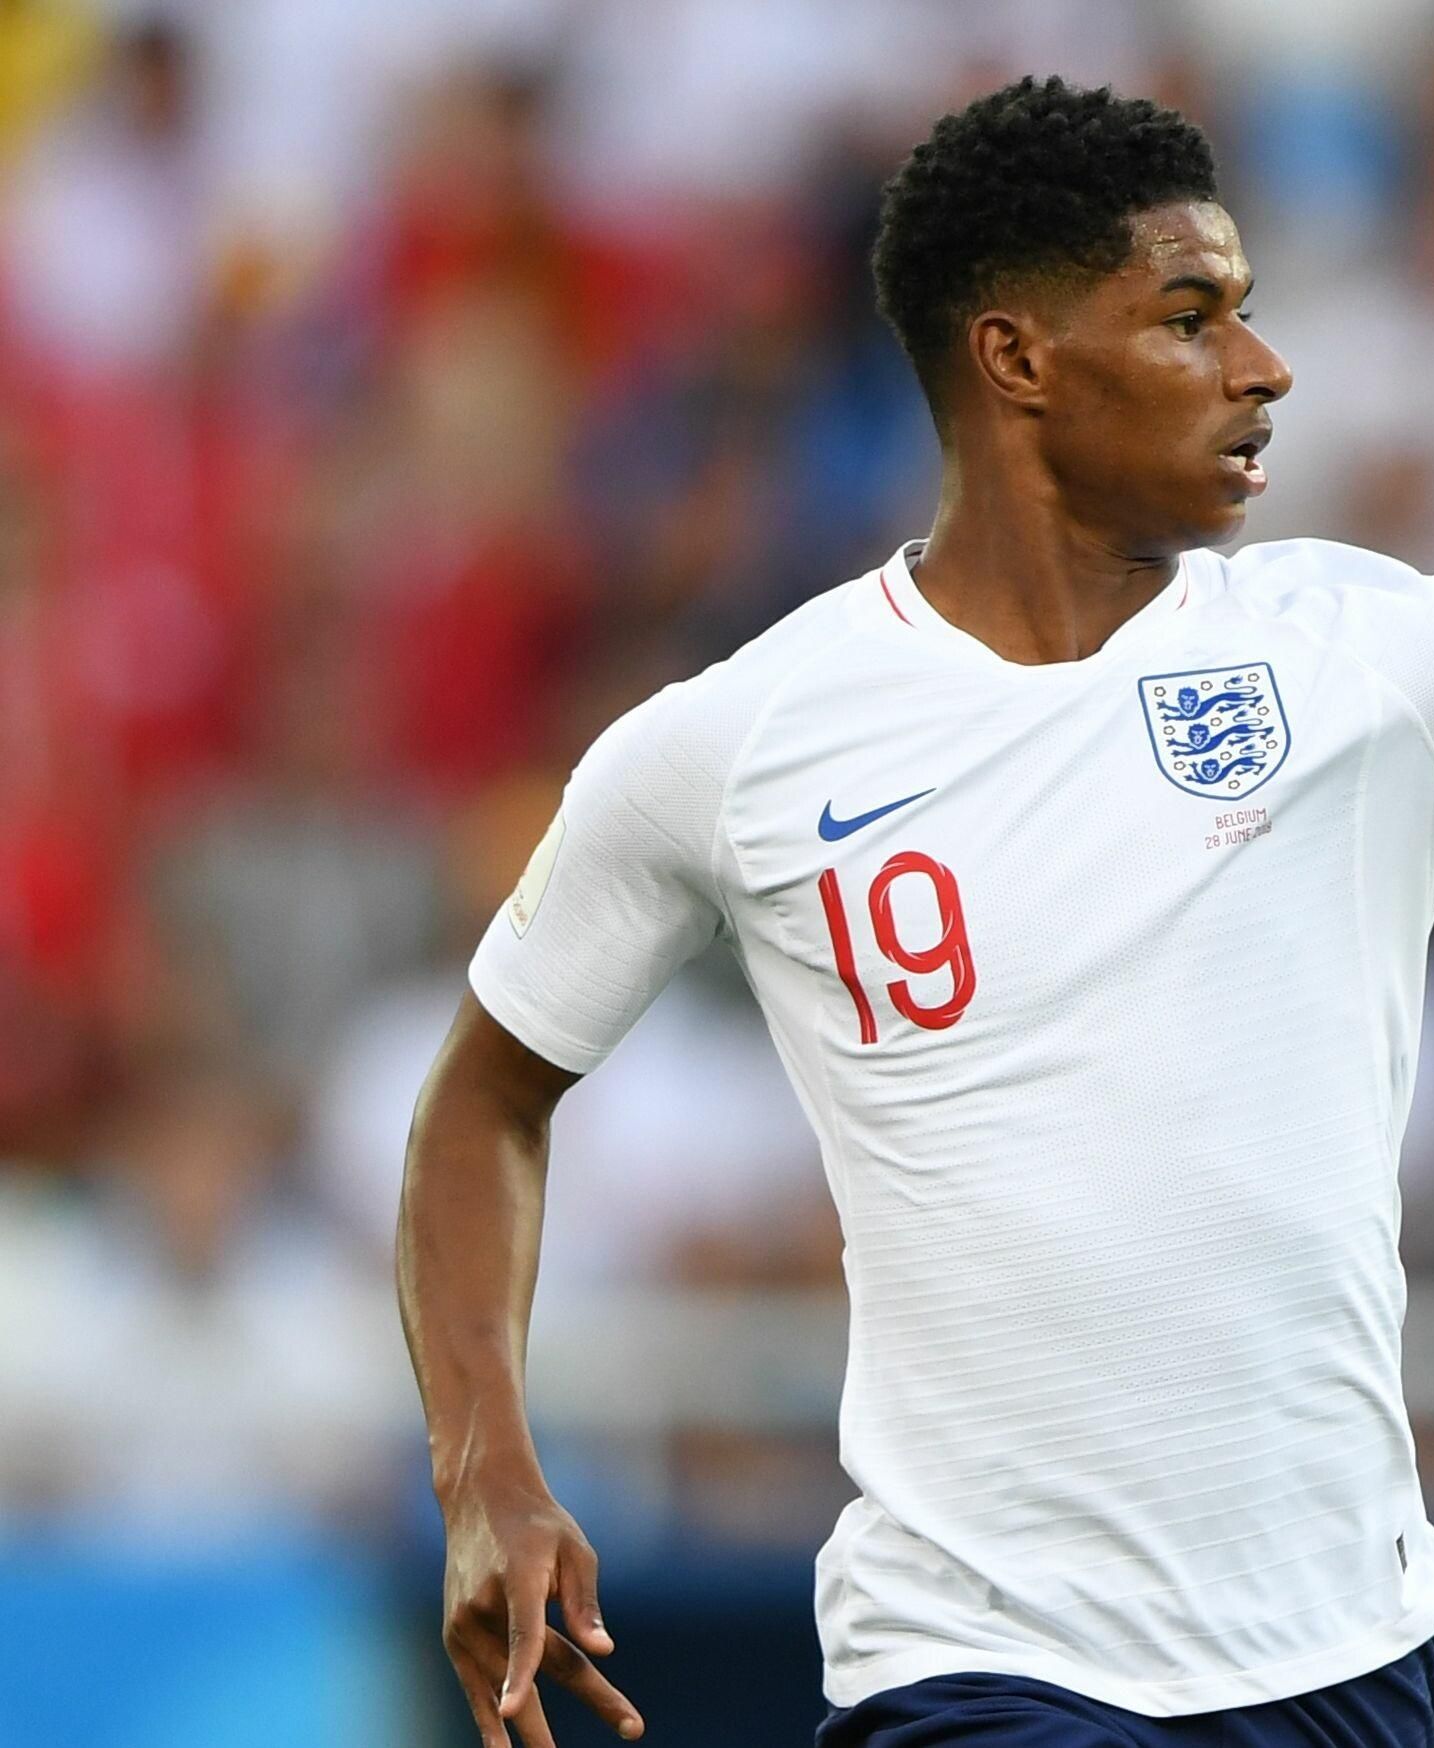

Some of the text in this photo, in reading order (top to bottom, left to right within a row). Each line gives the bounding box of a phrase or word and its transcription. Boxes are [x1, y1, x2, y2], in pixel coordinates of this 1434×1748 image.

[1215, 807, 1266, 830] BELGIUM
[1204, 834, 1221, 850] 28
[1224, 827, 1252, 845] JUNE
[818, 851, 976, 1045] 19
